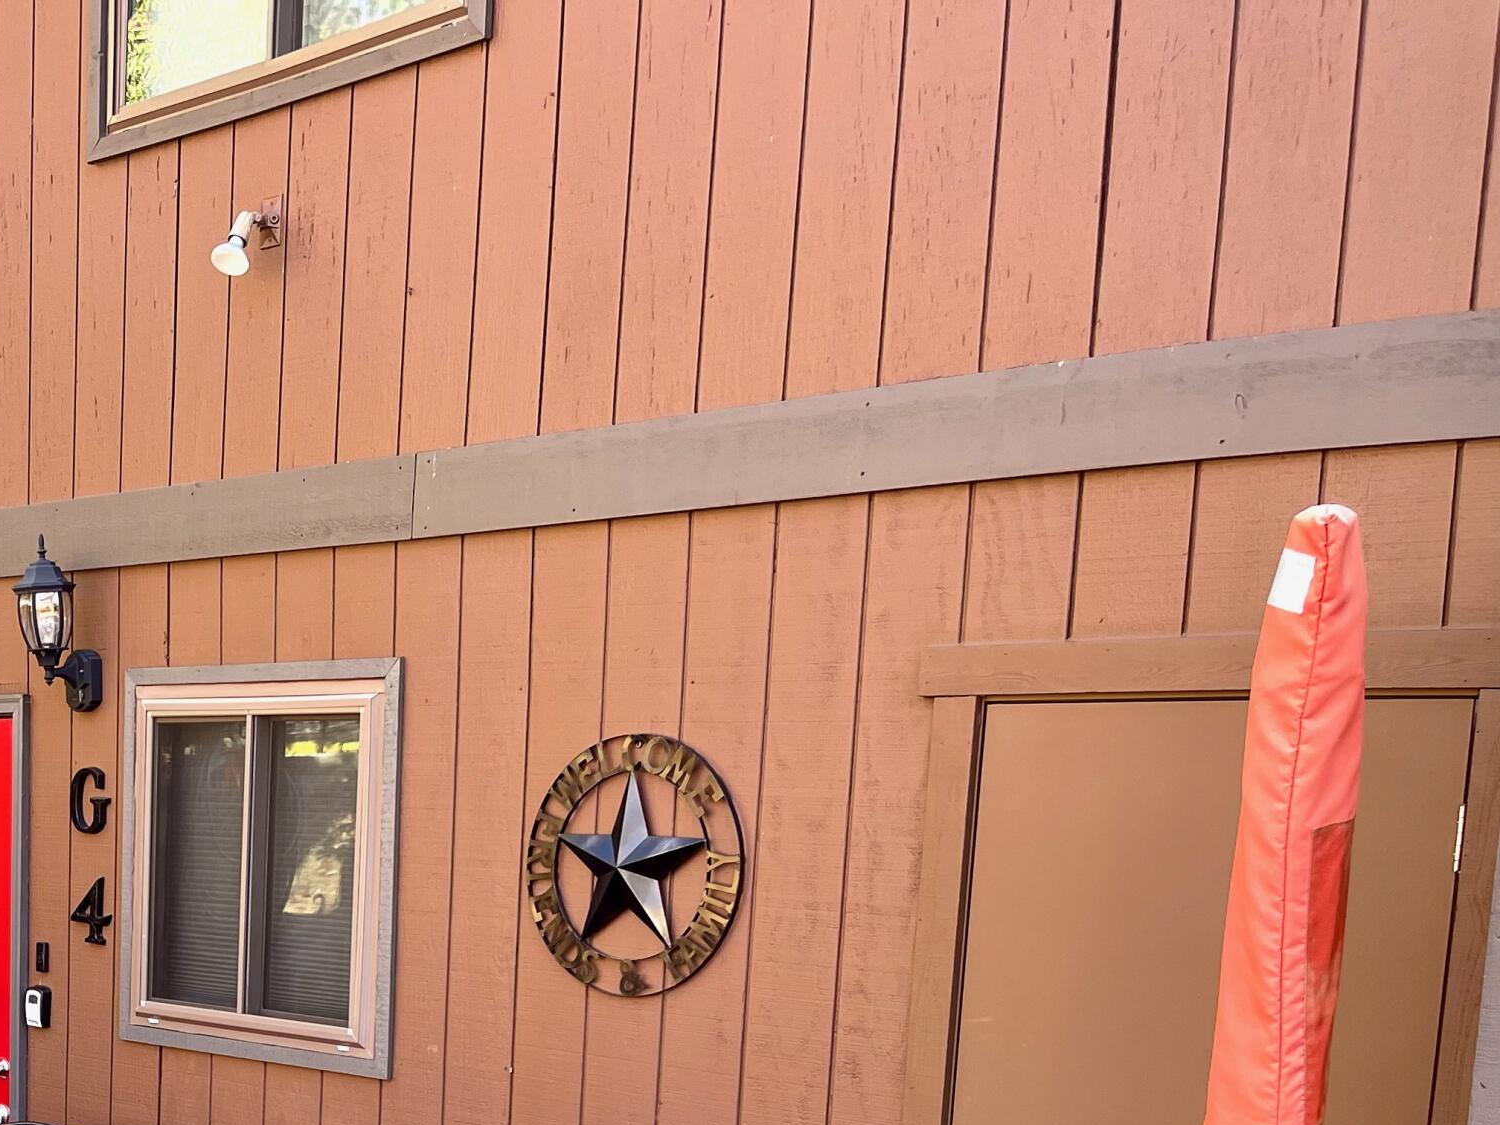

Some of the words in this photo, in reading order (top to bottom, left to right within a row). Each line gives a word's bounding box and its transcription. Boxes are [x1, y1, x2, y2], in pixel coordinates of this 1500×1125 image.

[70, 767, 111, 834] G
[549, 735, 724, 818] WELCOME
[71, 876, 112, 945] 4
[528, 810, 598, 984] FRIENDS
[620, 959, 647, 996] &
[661, 851, 740, 982] FAMILY
